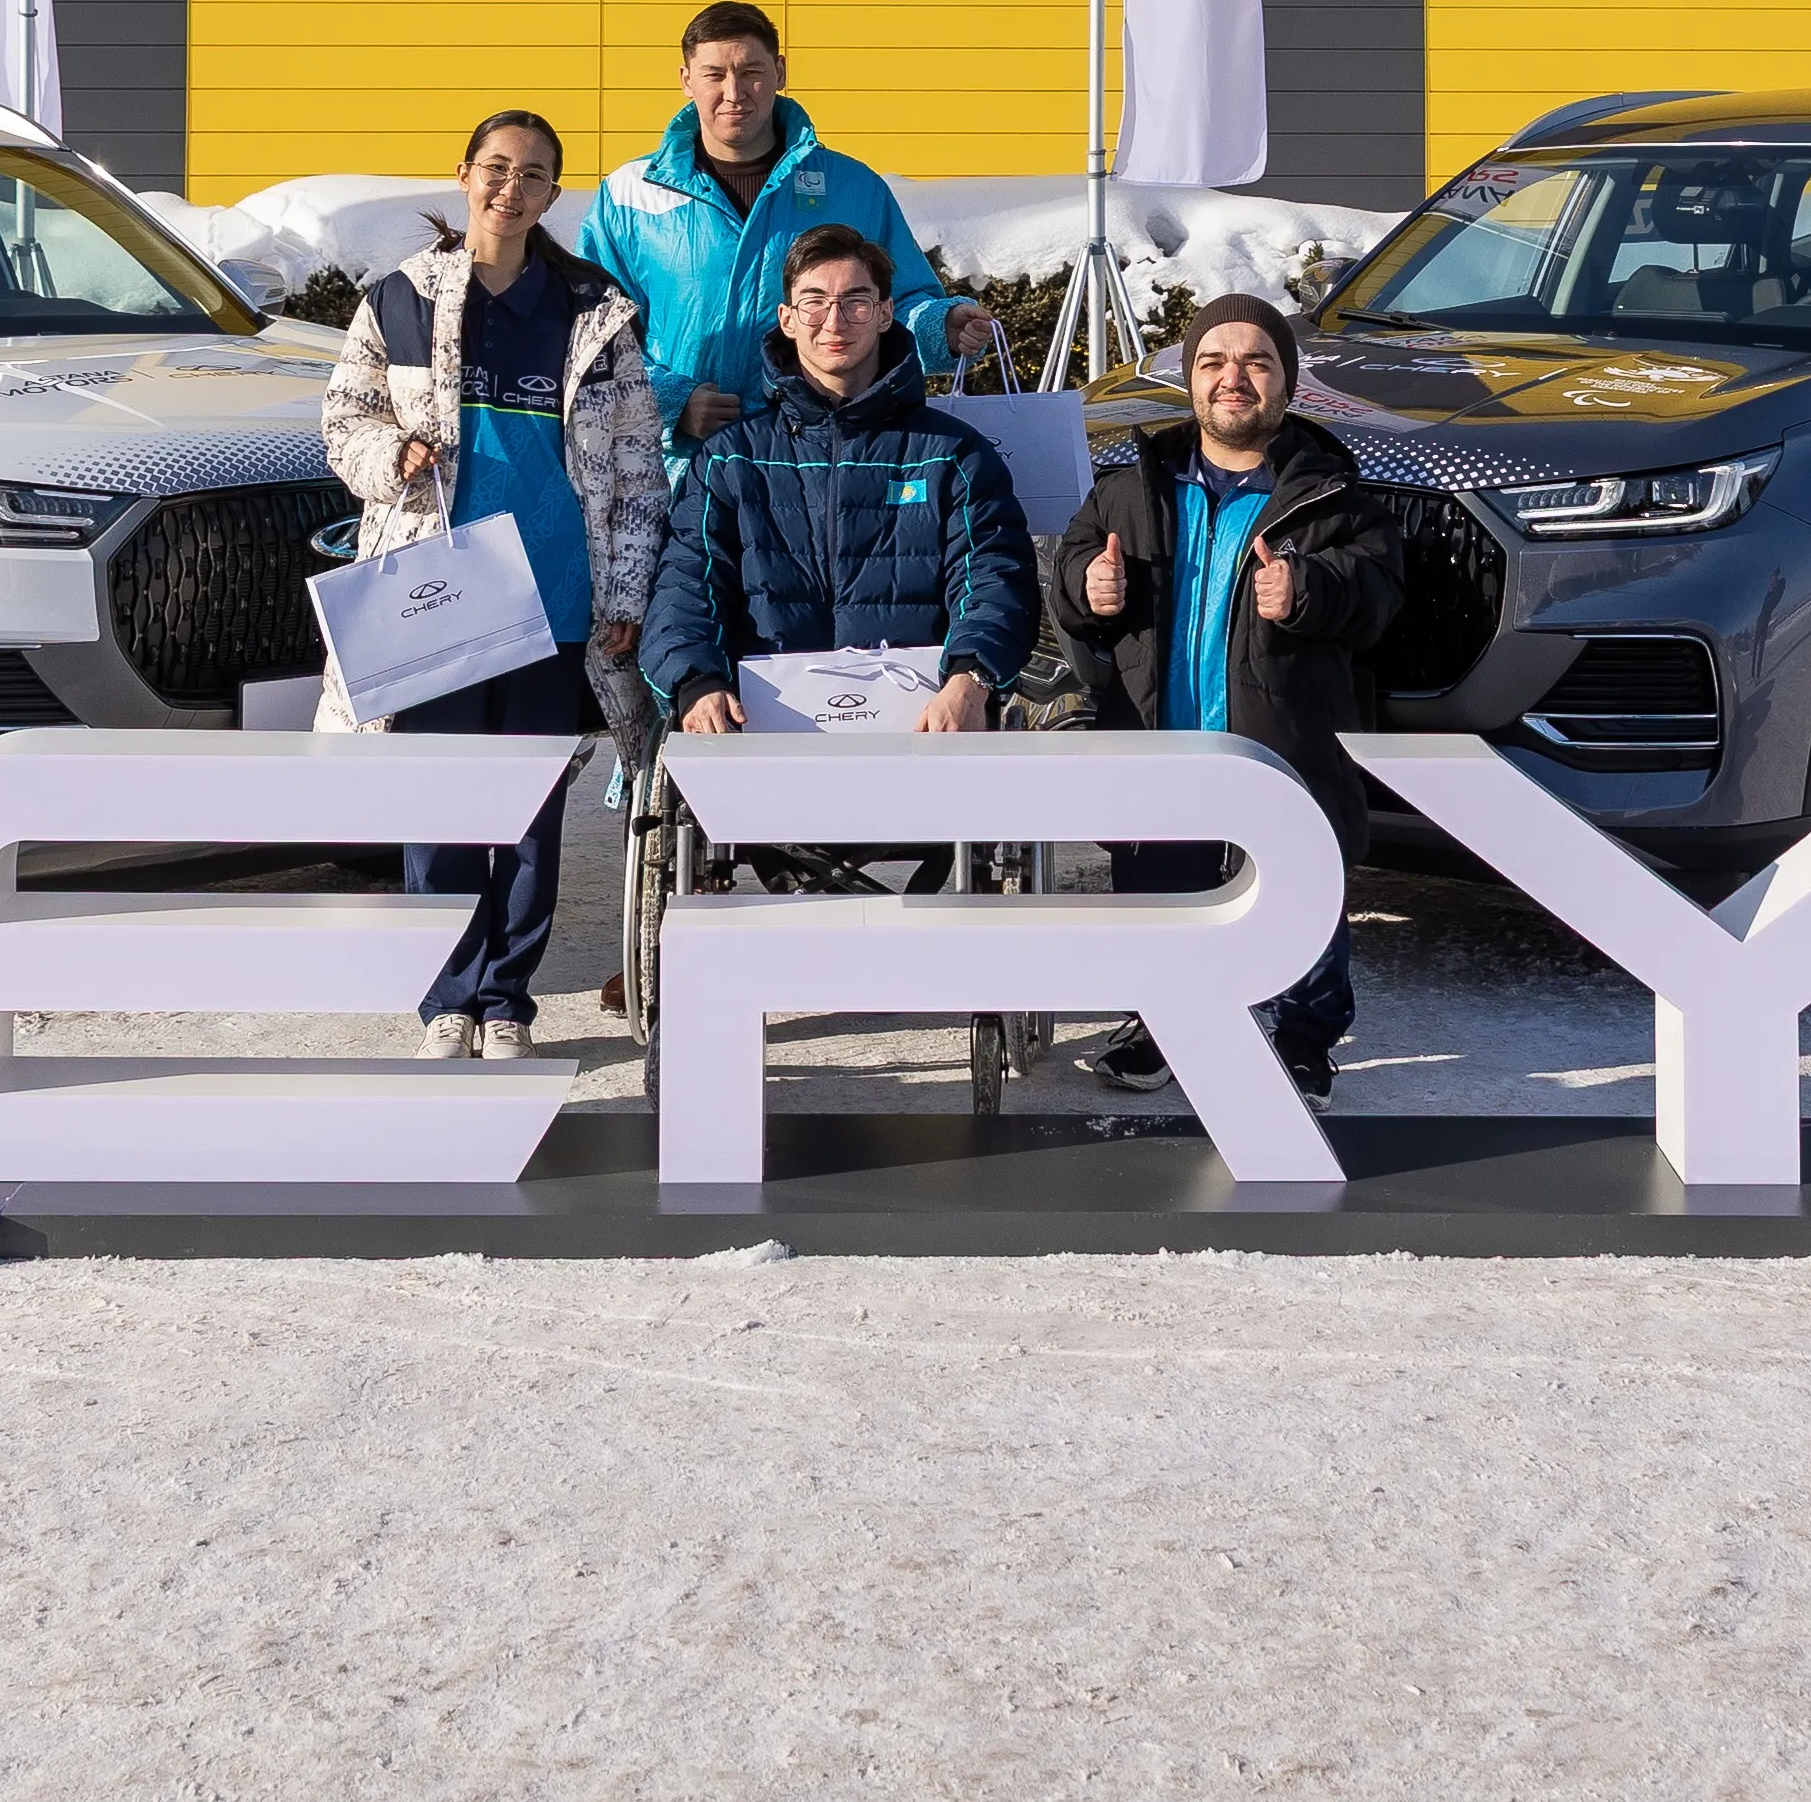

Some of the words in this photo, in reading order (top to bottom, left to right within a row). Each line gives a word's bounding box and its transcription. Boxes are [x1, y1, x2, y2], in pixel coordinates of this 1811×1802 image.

[1359, 363, 1522, 378] CHERY
[400, 589, 463, 619] CHERY
[814, 709, 881, 723] CHERY
